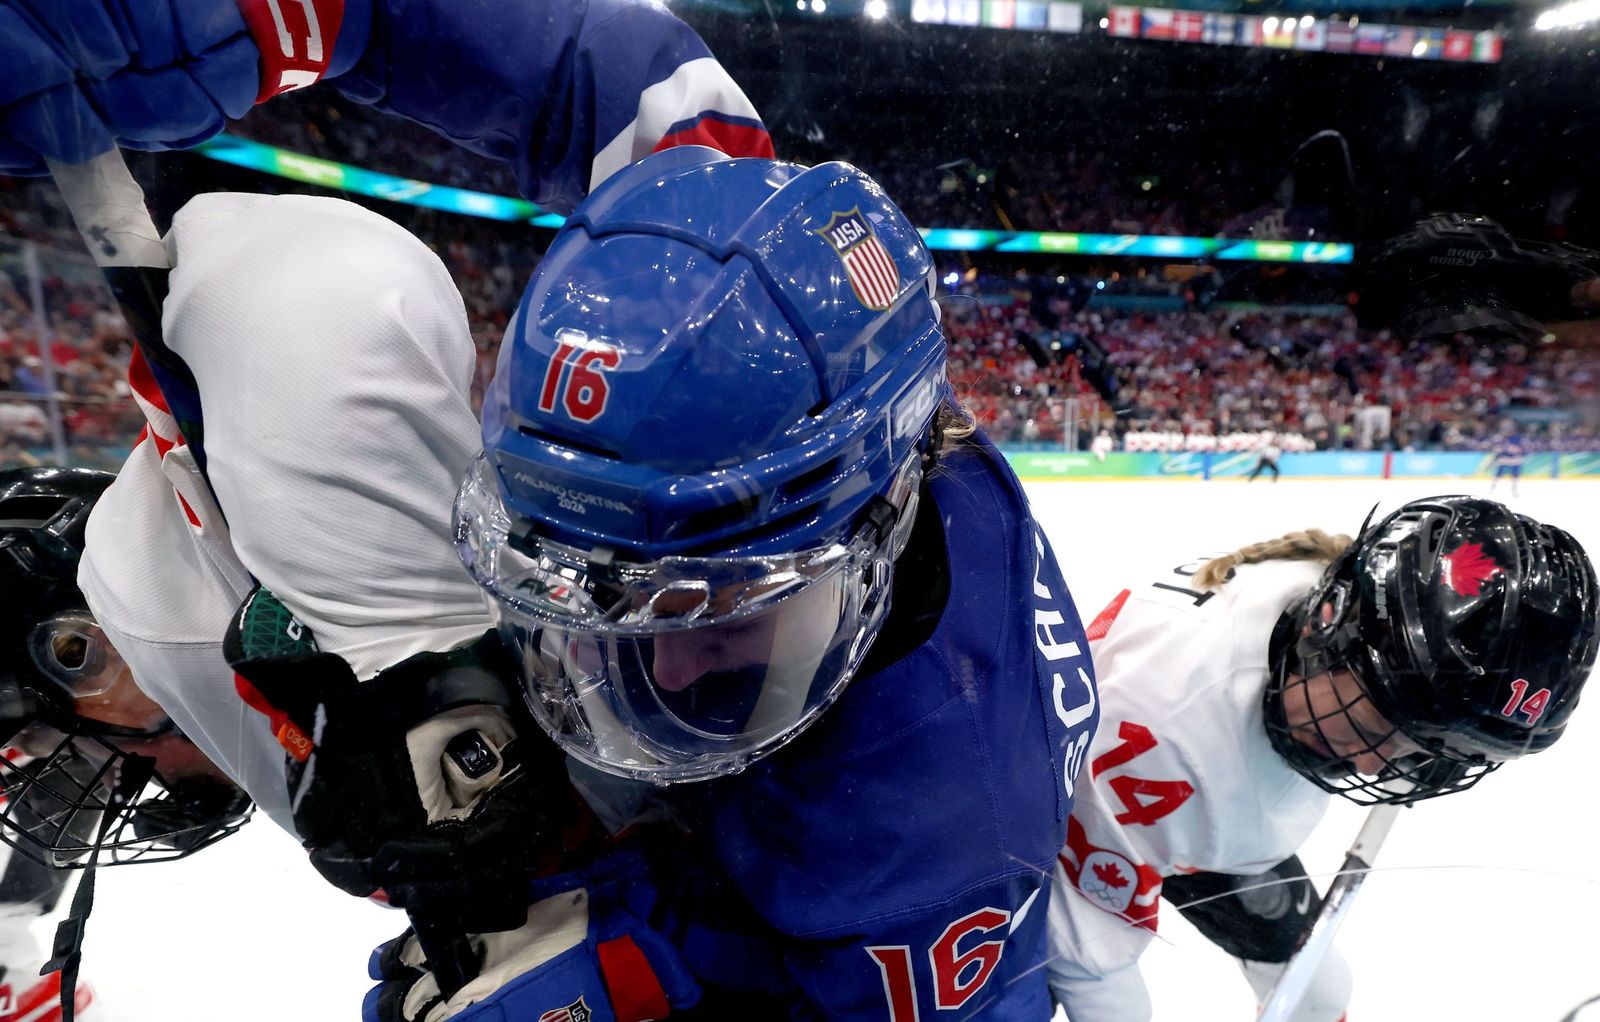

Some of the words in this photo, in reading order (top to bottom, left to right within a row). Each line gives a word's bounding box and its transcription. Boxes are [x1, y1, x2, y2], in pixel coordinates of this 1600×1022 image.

[831, 218, 866, 249] USA
[538, 333, 621, 424] 16
[514, 472, 567, 497] MILANO
[567, 489, 634, 515] CORTINA
[558, 496, 586, 514] 2026
[1501, 679, 1551, 725] 14
[1092, 721, 1194, 826] 14
[864, 906, 1011, 1022] 16
[572, 1006, 586, 1022] US
